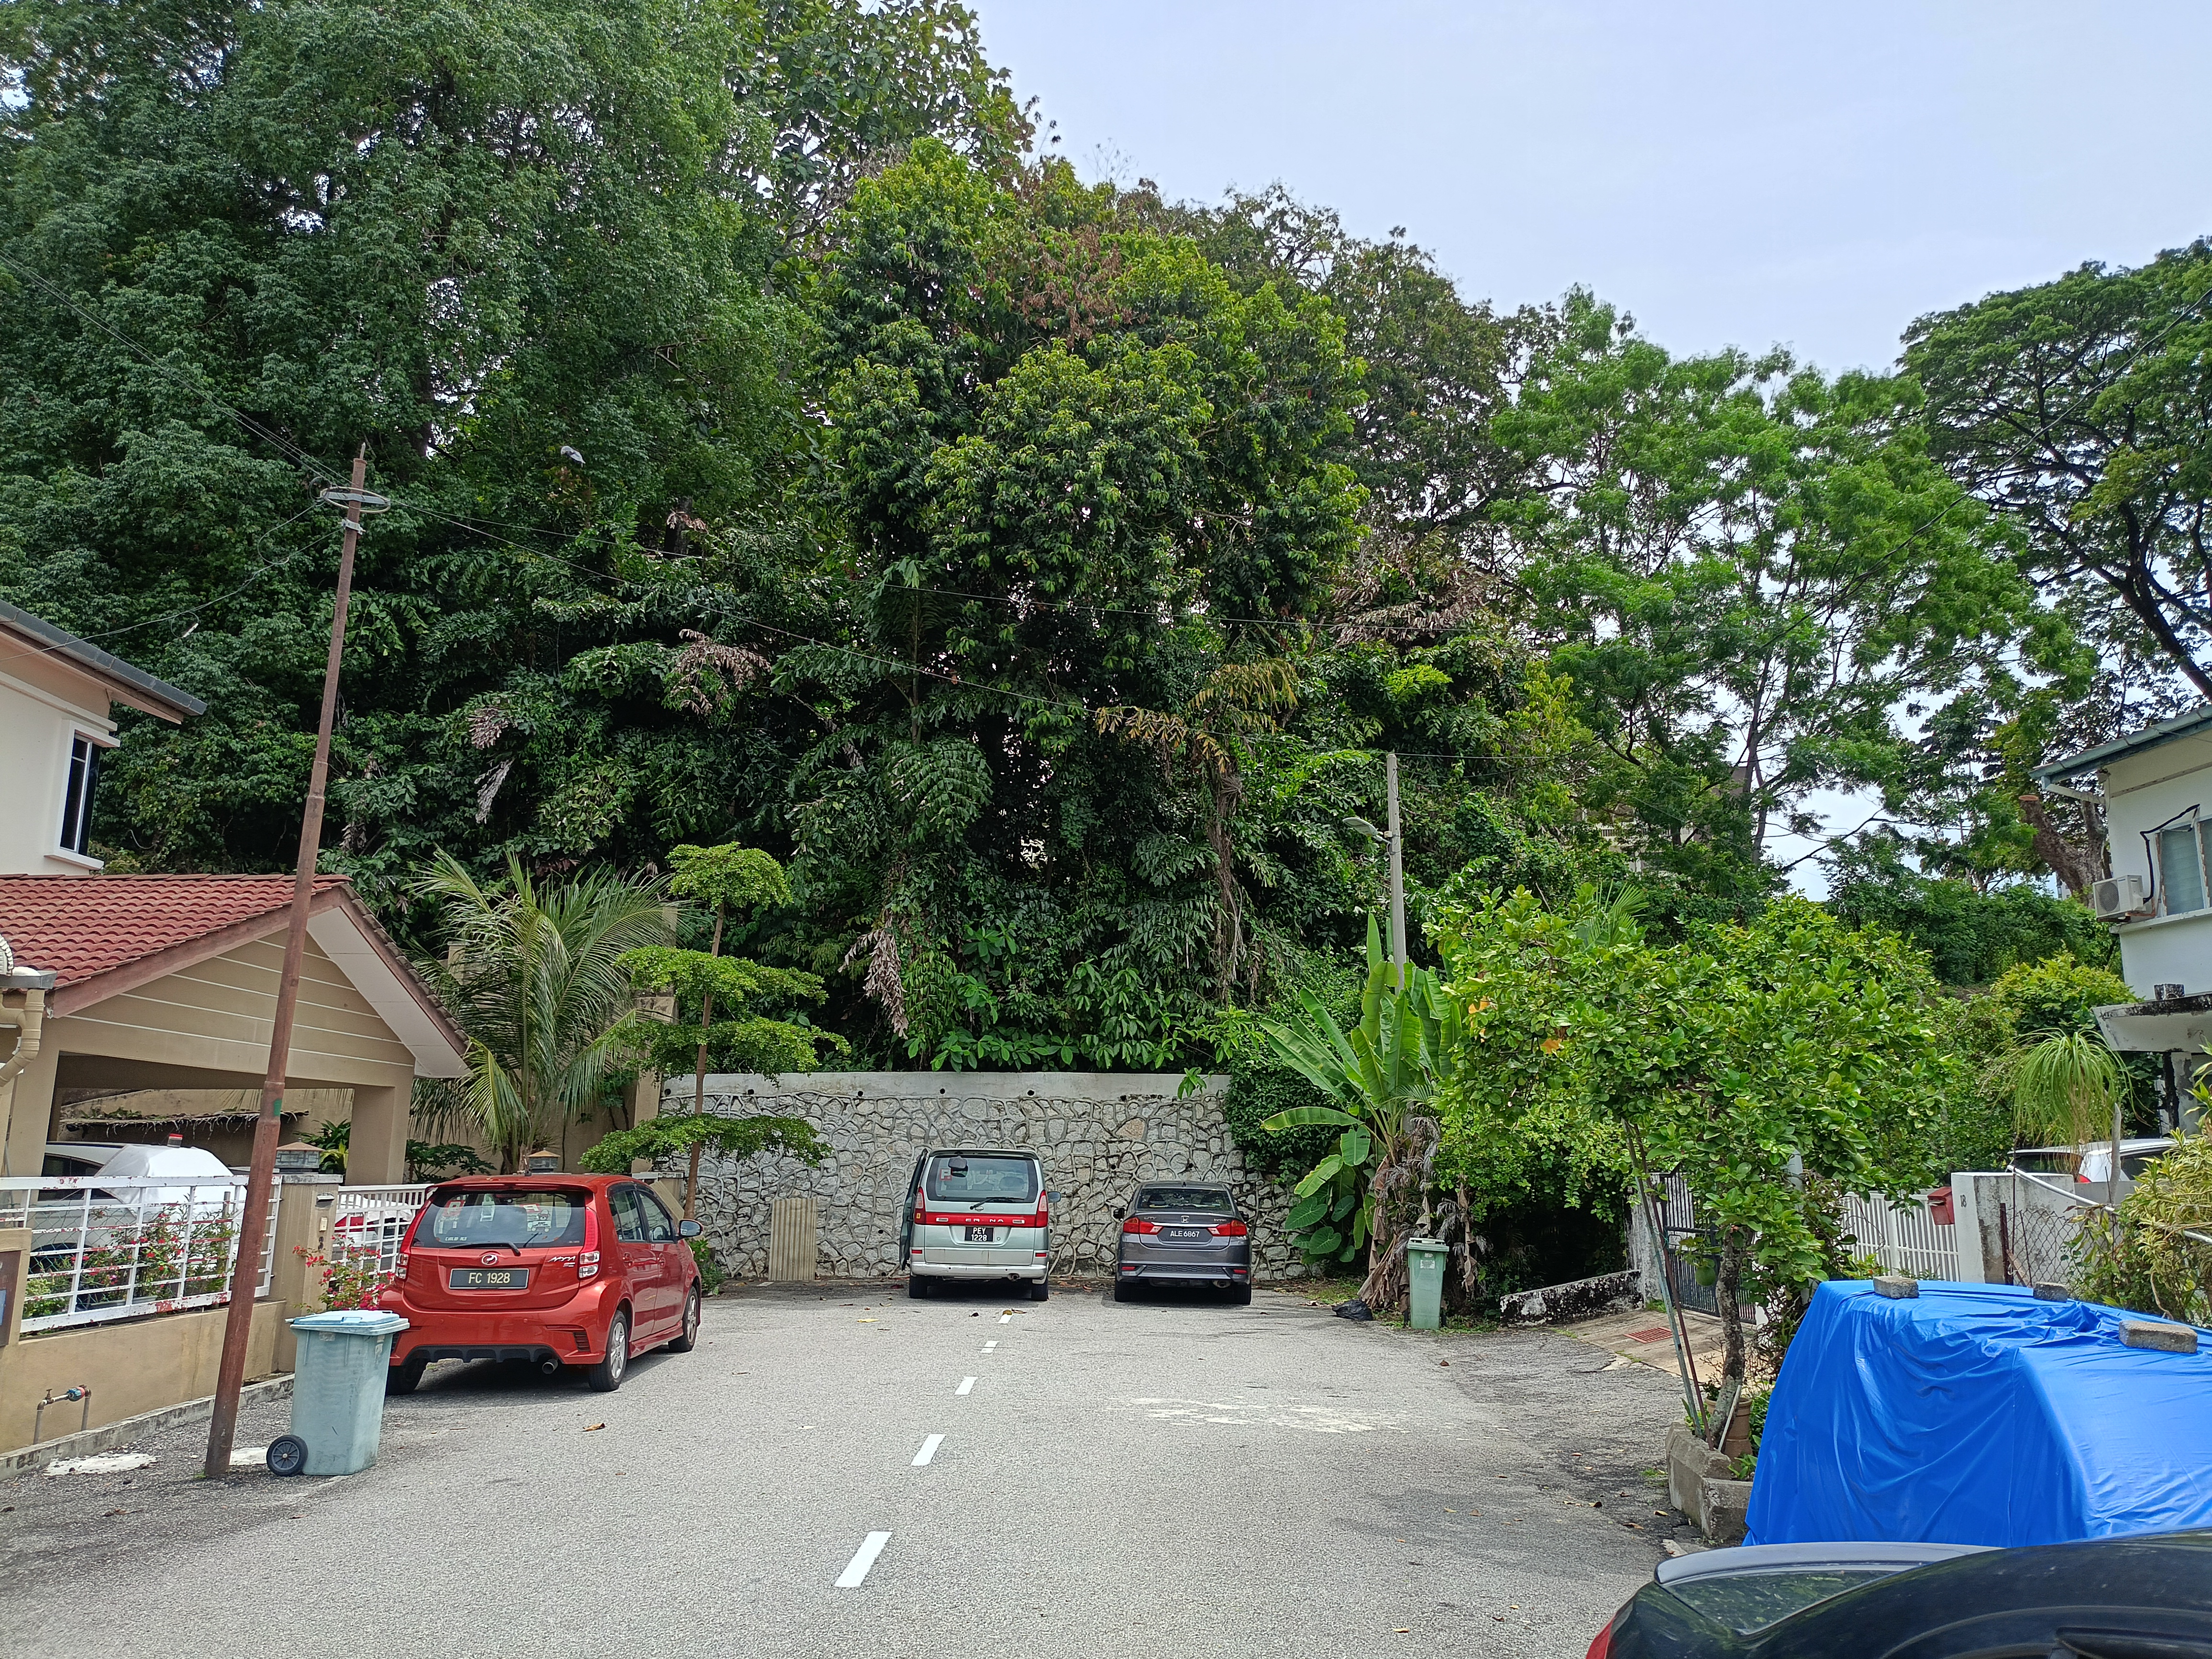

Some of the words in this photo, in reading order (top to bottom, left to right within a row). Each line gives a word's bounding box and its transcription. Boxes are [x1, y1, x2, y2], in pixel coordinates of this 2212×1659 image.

[1960, 1194, 1967, 1208] 18
[468, 1272, 482, 1284] FC
[487, 1272, 510, 1283] 1928
